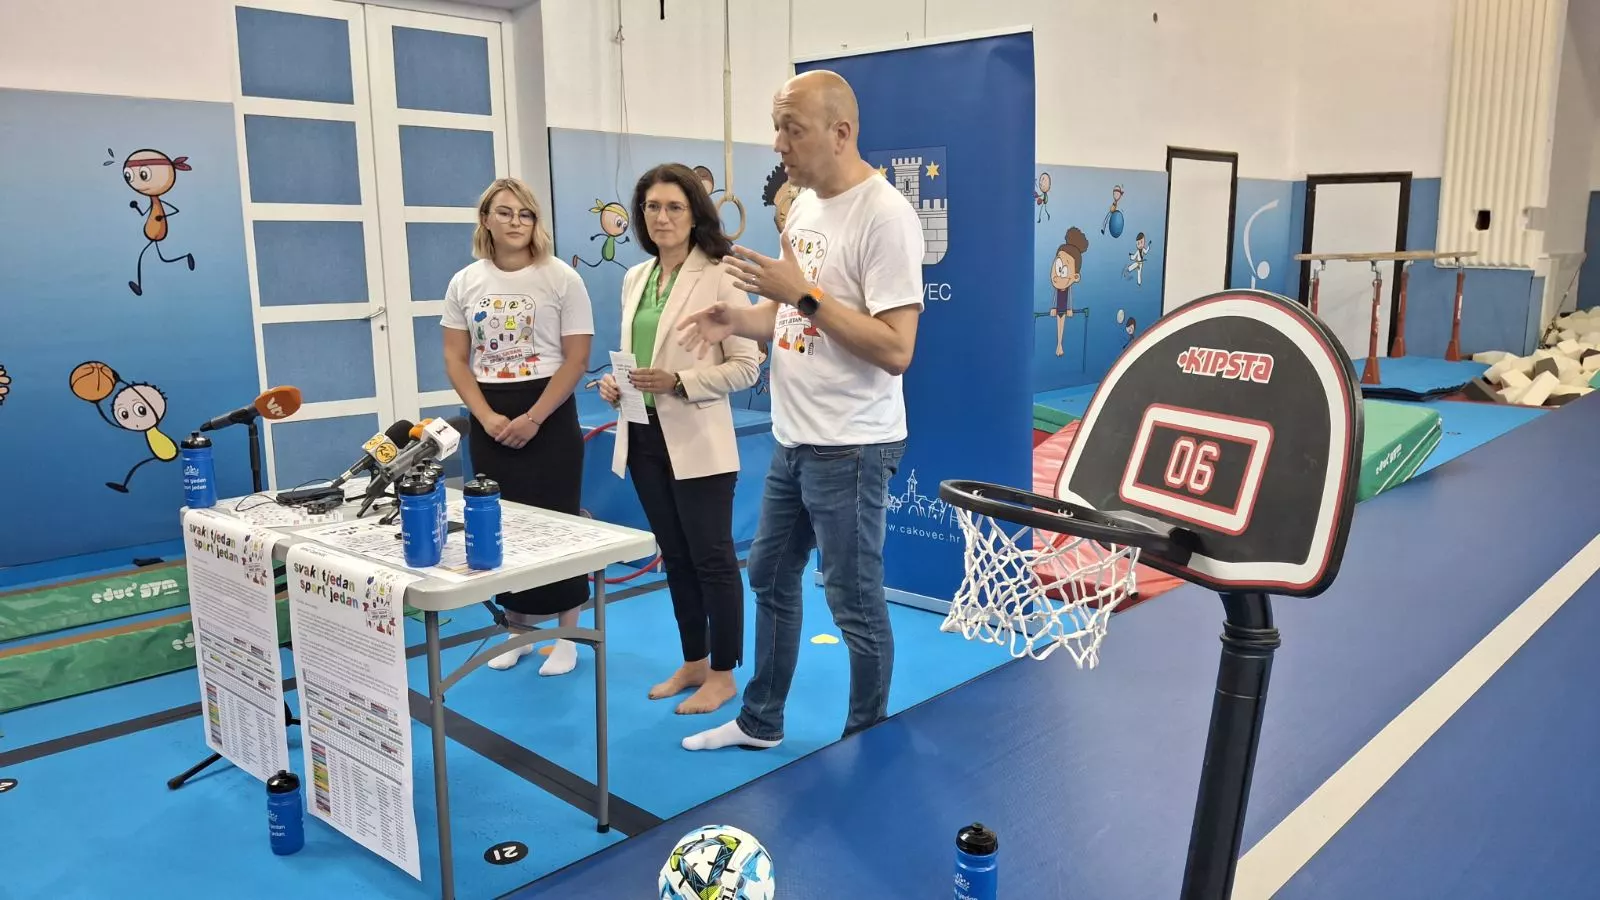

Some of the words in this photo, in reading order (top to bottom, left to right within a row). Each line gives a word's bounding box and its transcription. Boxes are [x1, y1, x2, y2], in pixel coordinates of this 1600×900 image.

[1180, 346, 1275, 384] KIPSTA
[1163, 436, 1221, 496] 06
[210, 529, 236, 549] tjedan
[887, 523, 960, 543] w.cakovec.hr
[216, 545, 239, 564] jedan
[294, 562, 320, 580] svaki
[322, 569, 355, 592] tjedan
[300, 579, 326, 598] sport
[330, 586, 359, 609] jedan
